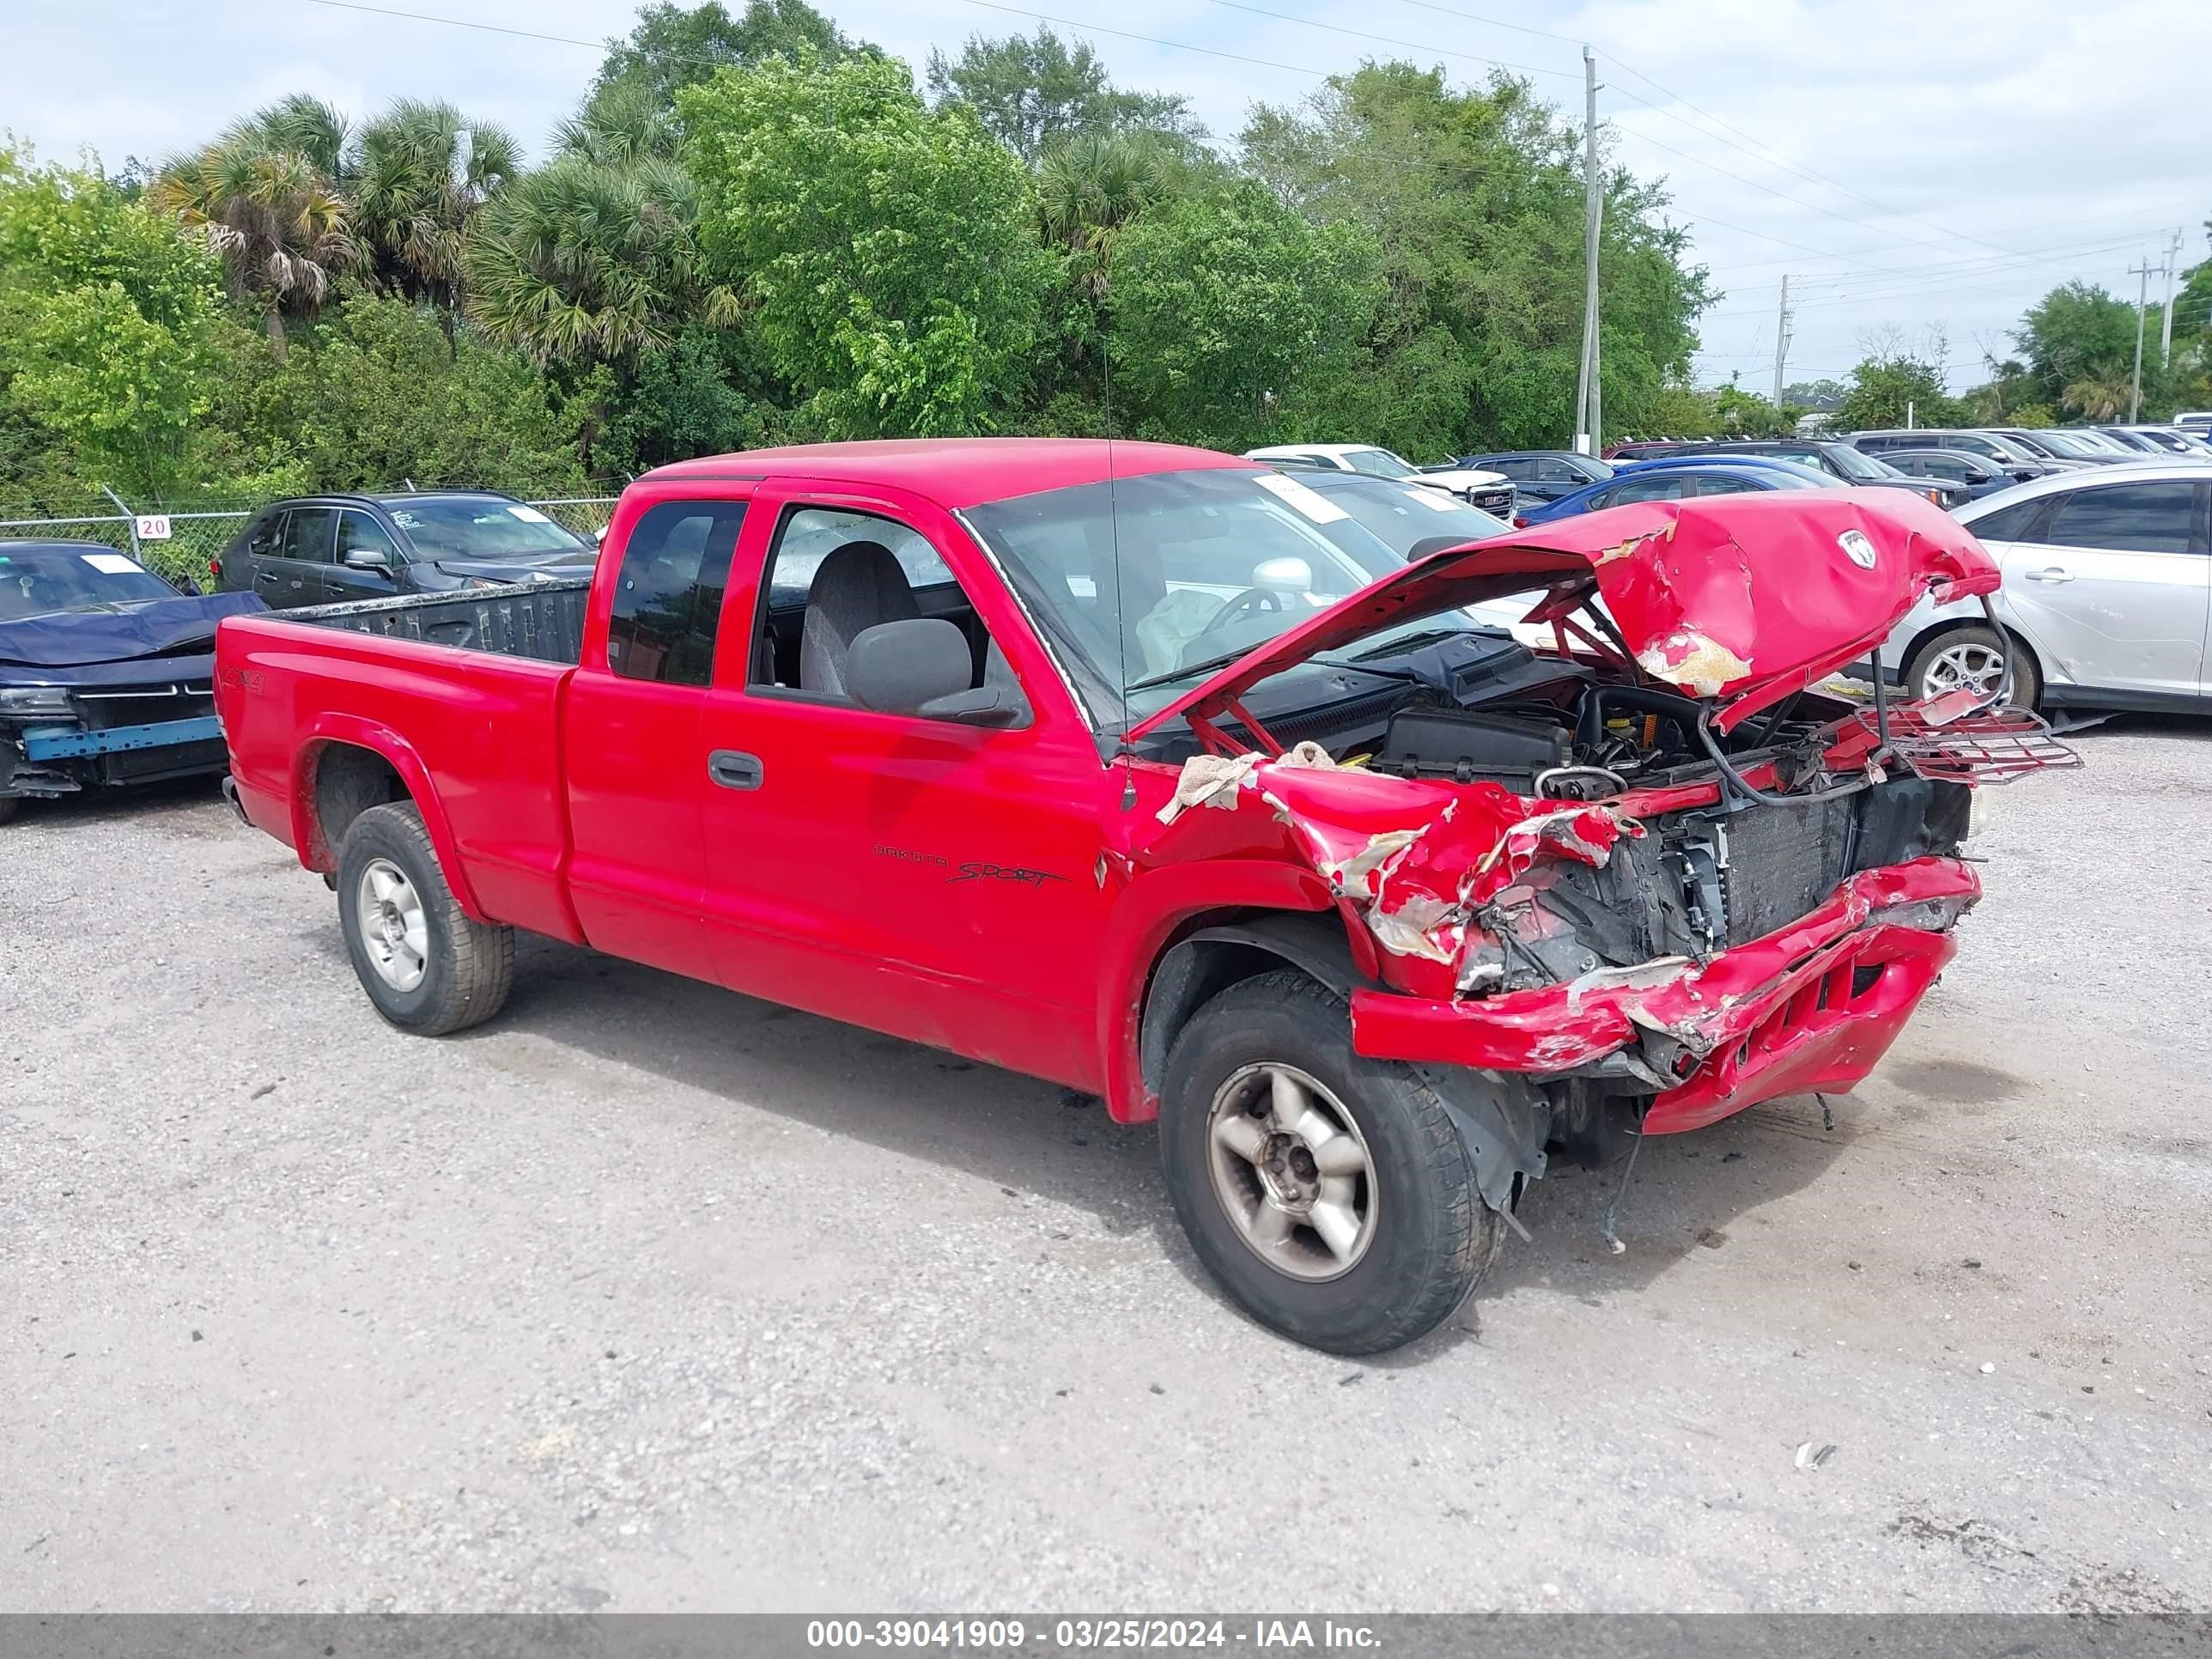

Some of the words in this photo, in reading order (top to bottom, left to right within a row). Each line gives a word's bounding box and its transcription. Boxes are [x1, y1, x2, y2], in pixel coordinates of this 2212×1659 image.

[143, 520, 165, 534] 20
[872, 844, 949, 867] DAKOTA
[945, 862, 1072, 891] SPORT
